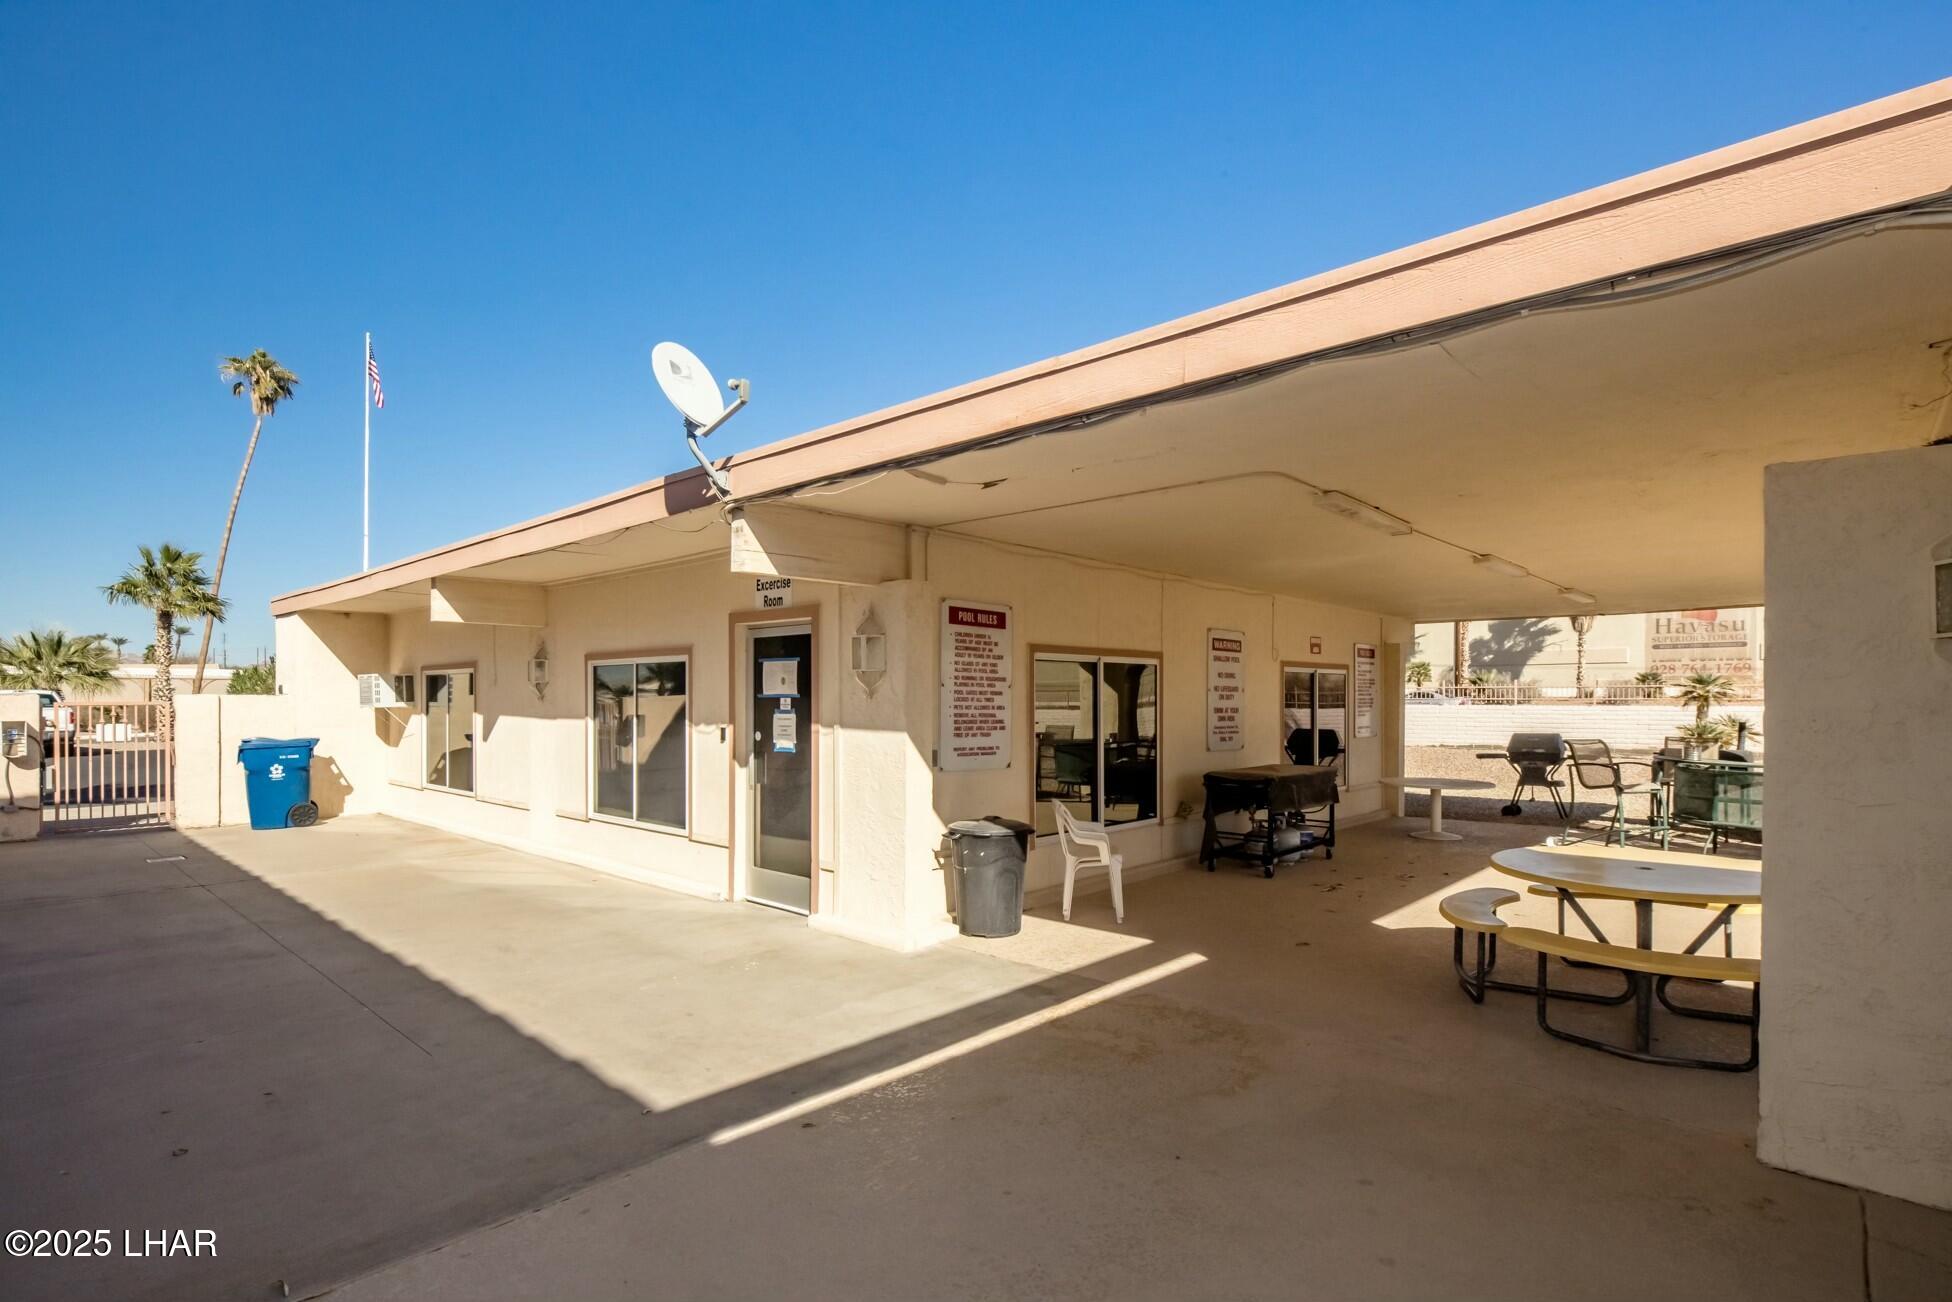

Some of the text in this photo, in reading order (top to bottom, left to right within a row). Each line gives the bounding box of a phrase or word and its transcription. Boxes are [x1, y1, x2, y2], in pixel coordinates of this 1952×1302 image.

[756, 577, 791, 591] Excercise
[763, 595, 783, 607] Room
[958, 611, 998, 625] POOL RULES
[1655, 618, 1745, 634] Havasu
[1213, 639, 1241, 651] WARNING
[1651, 635, 1698, 643] SUPERIOR
